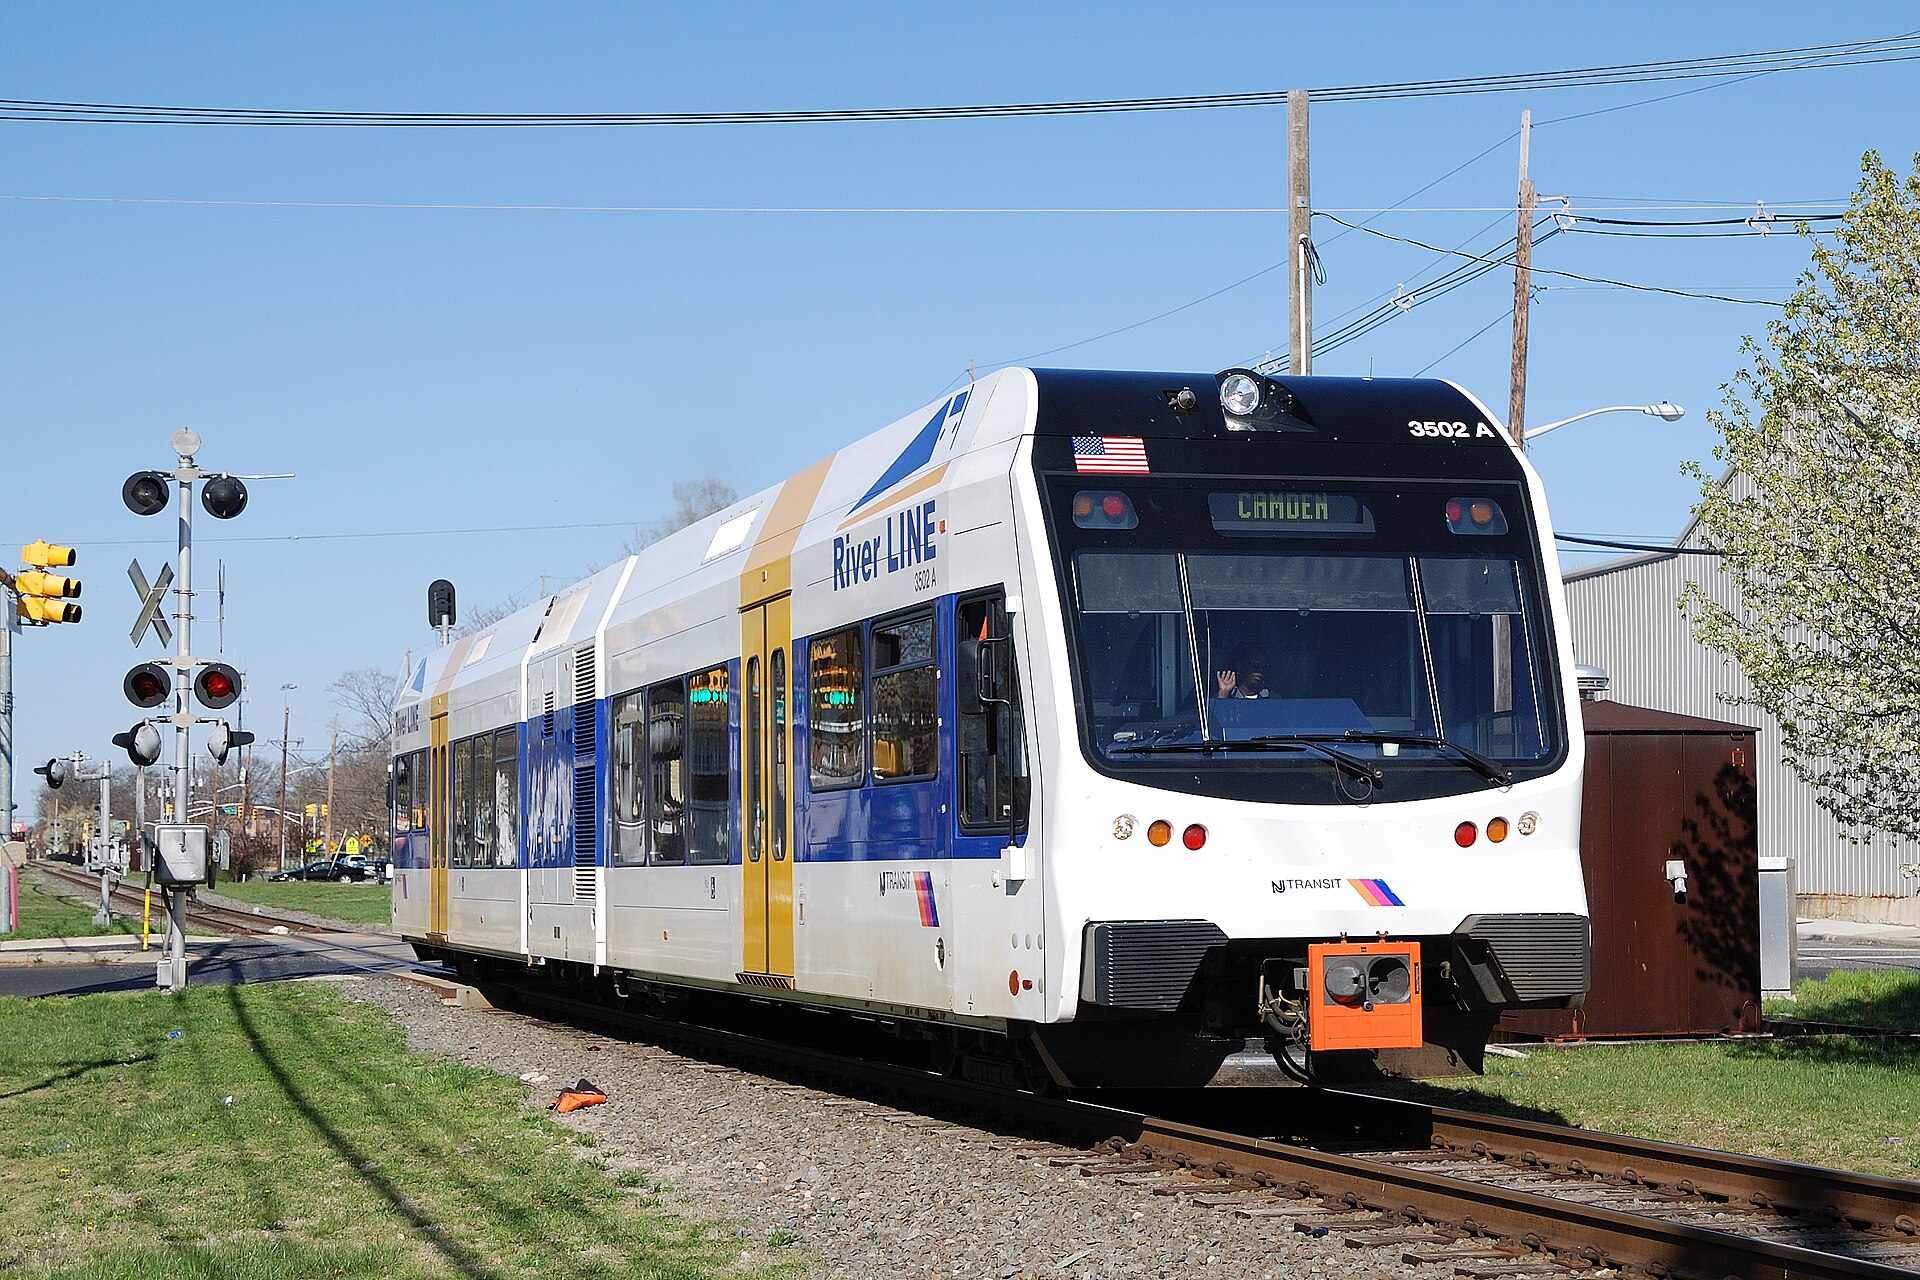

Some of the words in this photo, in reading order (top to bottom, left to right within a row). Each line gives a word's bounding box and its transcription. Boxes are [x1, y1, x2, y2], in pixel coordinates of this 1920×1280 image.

[1407, 420, 1471, 438] 3502
[1475, 421, 1496, 438] A
[1238, 492, 1328, 520] CAMDEN
[833, 533, 881, 592] River
[887, 499, 937, 574] LINE
[914, 569, 930, 592] 3502
[931, 567, 937, 588] A
[886, 871, 911, 890] TRANSIT
[1271, 879, 1286, 894] NJ
[1286, 878, 1342, 889] TRANSIT
